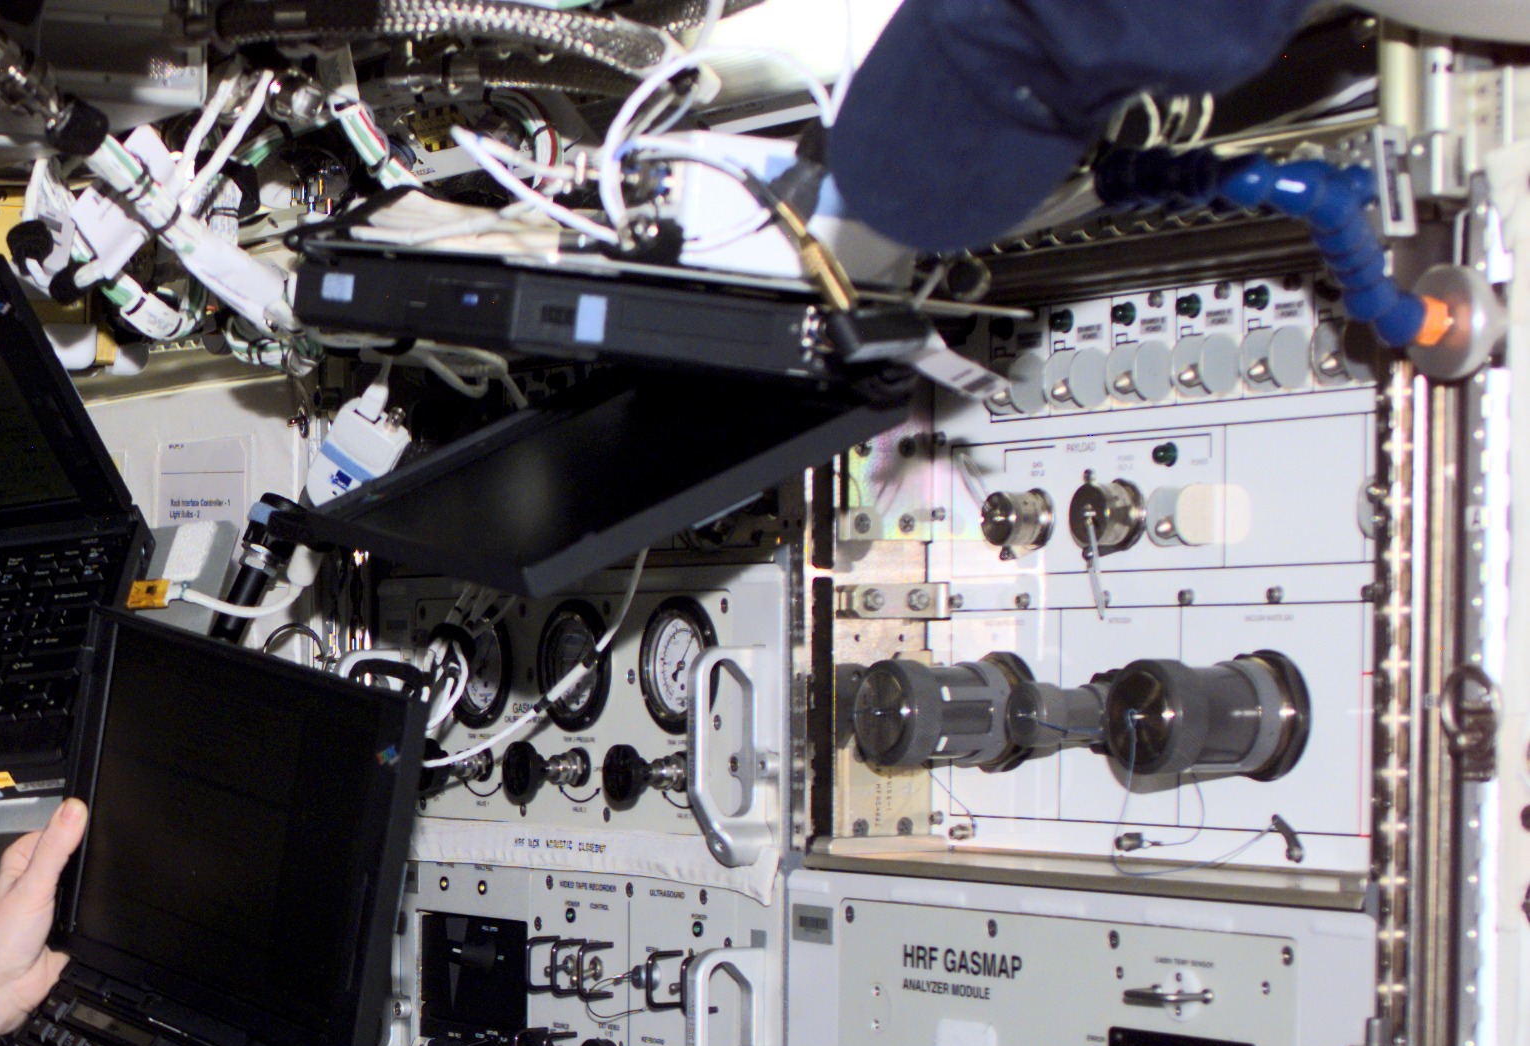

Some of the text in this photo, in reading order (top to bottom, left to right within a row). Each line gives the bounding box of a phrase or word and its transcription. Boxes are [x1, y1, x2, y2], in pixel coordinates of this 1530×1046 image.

[650, 889, 685, 899] ULTRASOUND
[903, 944, 1022, 979] HRF GASMAP
[903, 978, 990, 1000] ANALYZER MODULE
